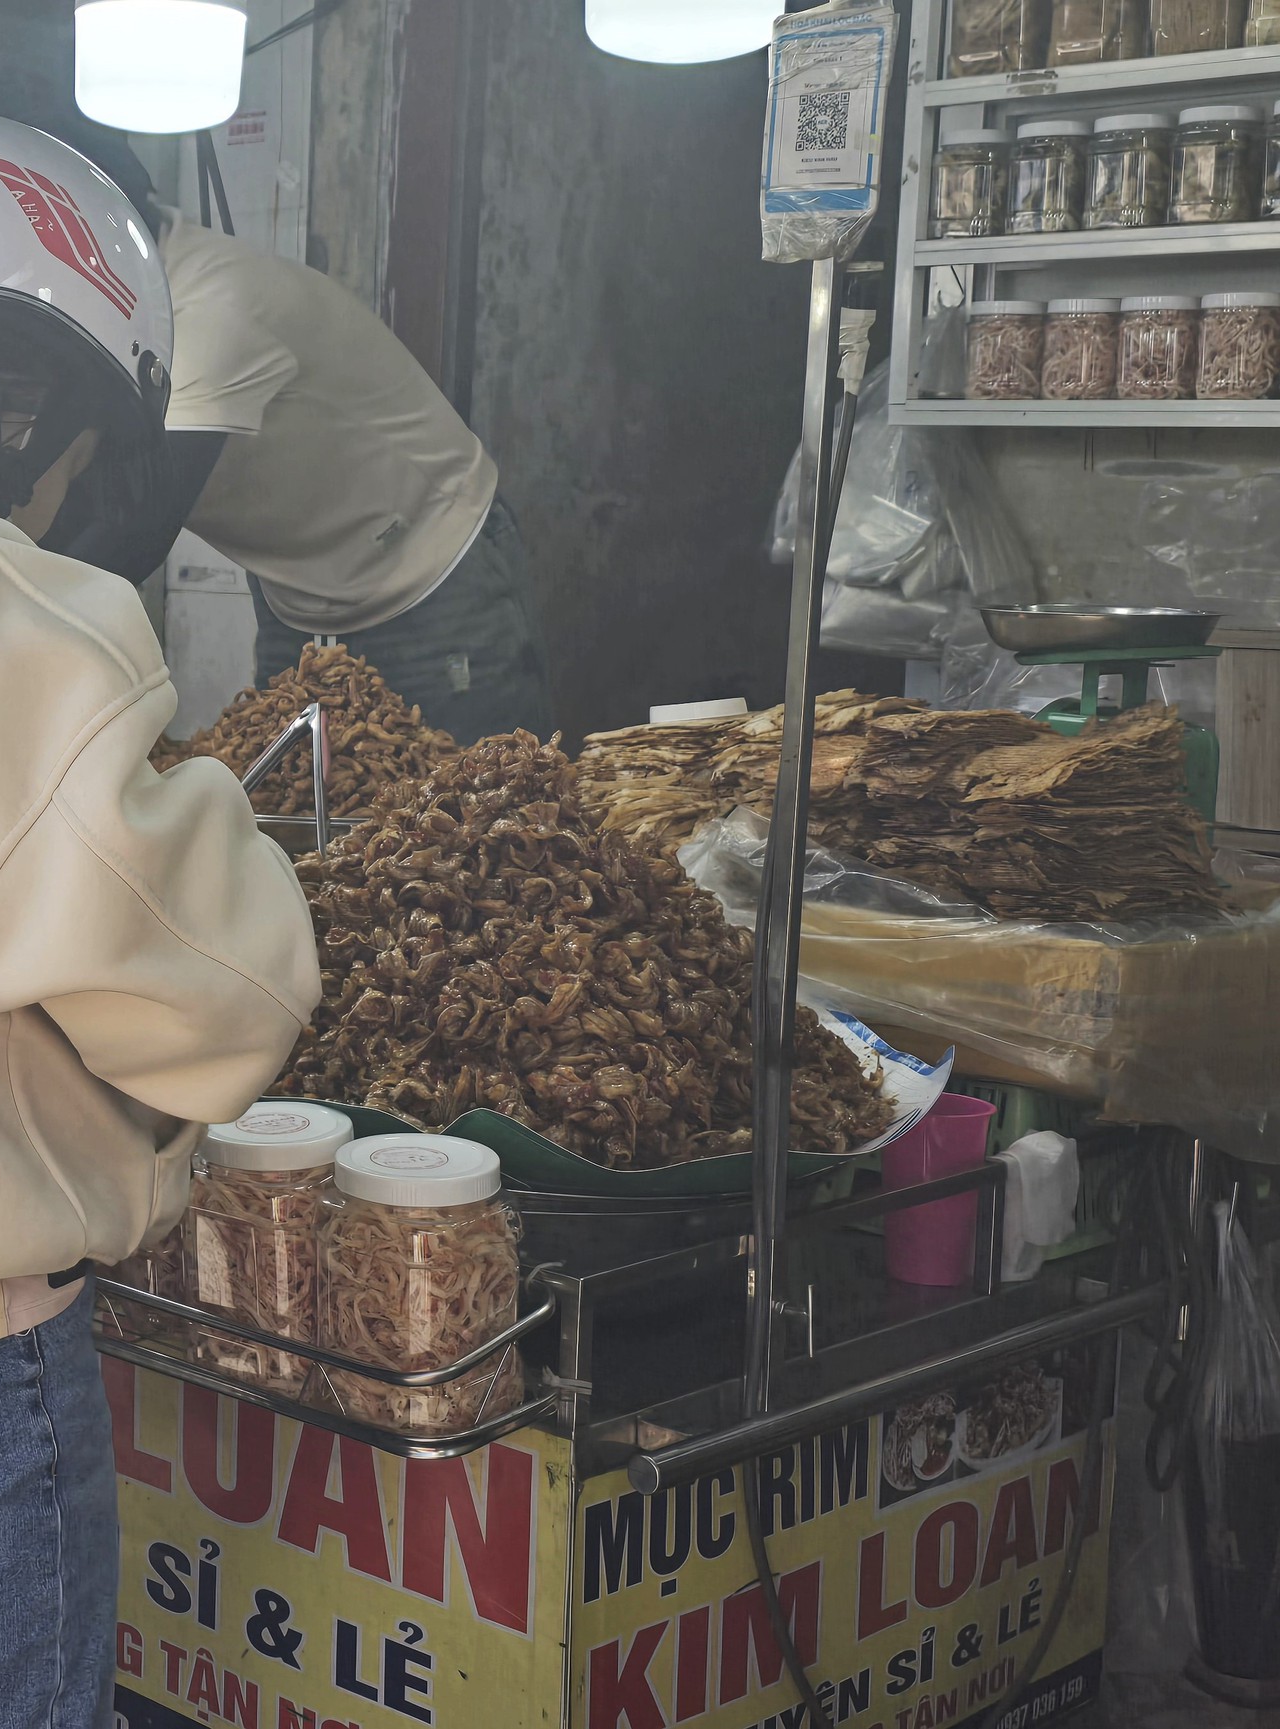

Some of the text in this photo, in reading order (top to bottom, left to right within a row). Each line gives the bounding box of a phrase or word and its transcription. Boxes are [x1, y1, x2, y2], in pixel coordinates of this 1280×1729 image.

[147, 1539, 432, 1725] SỈ & LẺ
[588, 1442, 1104, 1729] KIM LOAN
[159, 1639, 259, 1729] TẬN
[886, 1627, 936, 1696] SỈ
[951, 1623, 984, 1668] &
